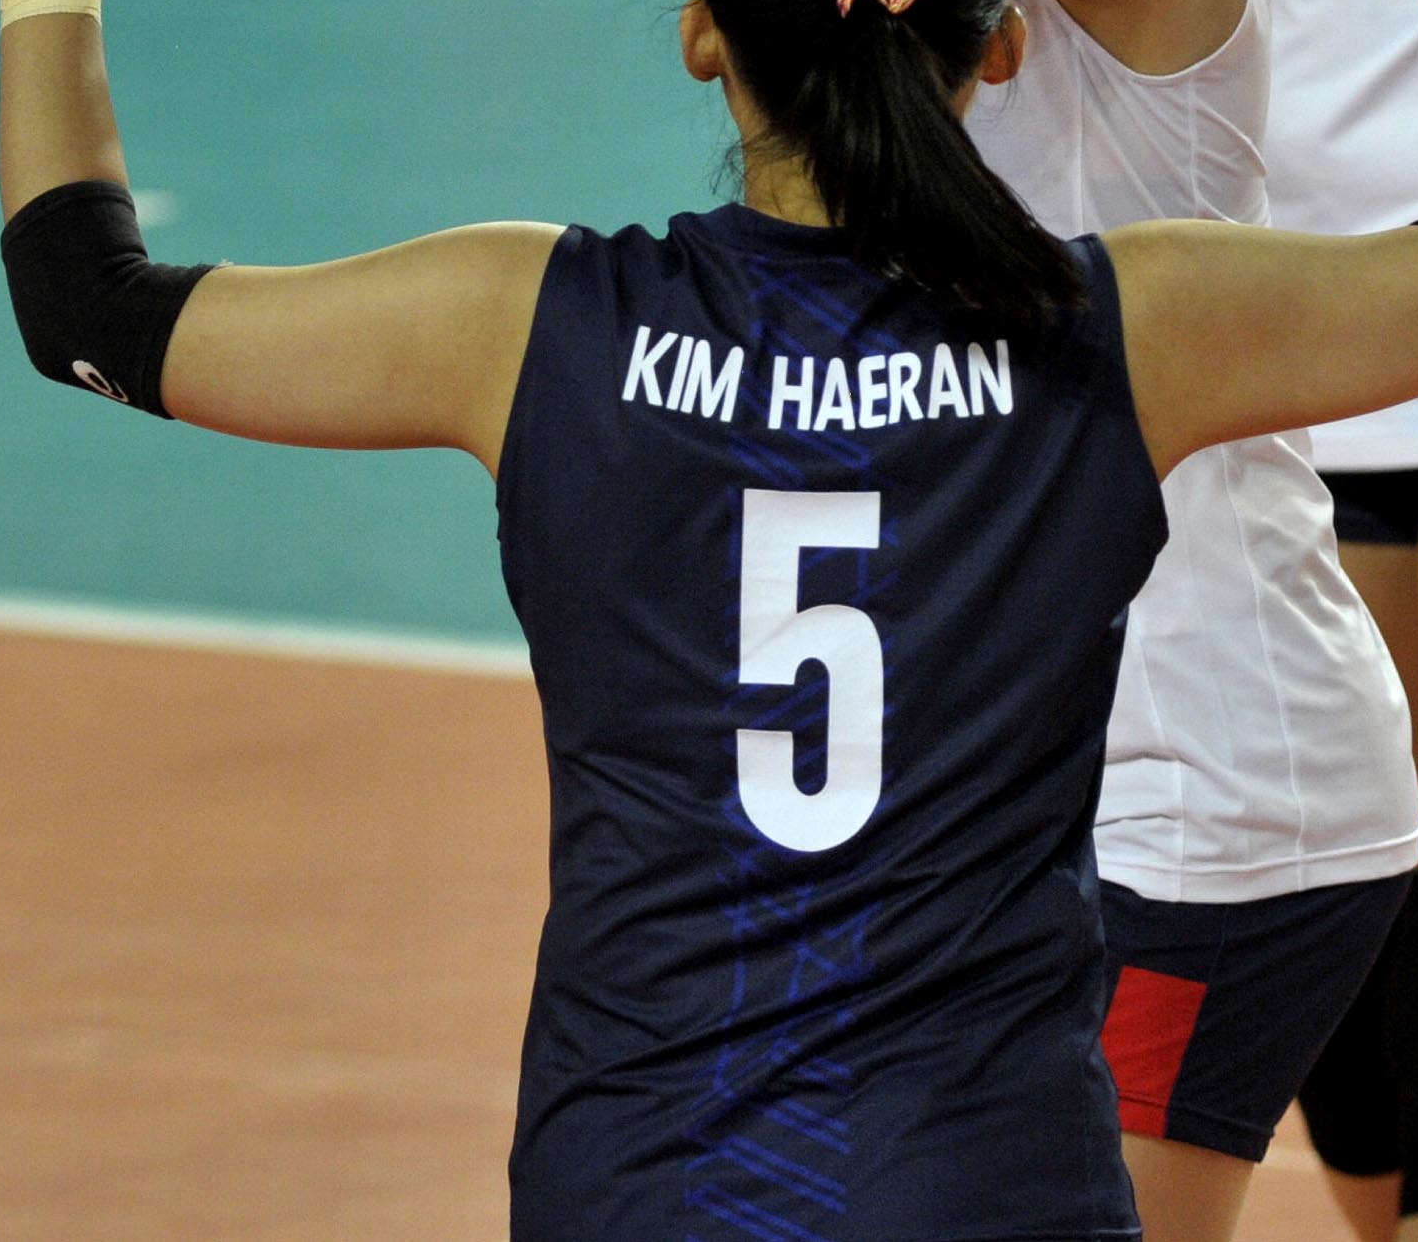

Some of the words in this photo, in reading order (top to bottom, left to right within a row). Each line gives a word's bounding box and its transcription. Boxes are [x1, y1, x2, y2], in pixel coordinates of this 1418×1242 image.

[621, 324, 746, 423] KIM
[768, 338, 1014, 432] HAERAN
[735, 488, 885, 852] 5
